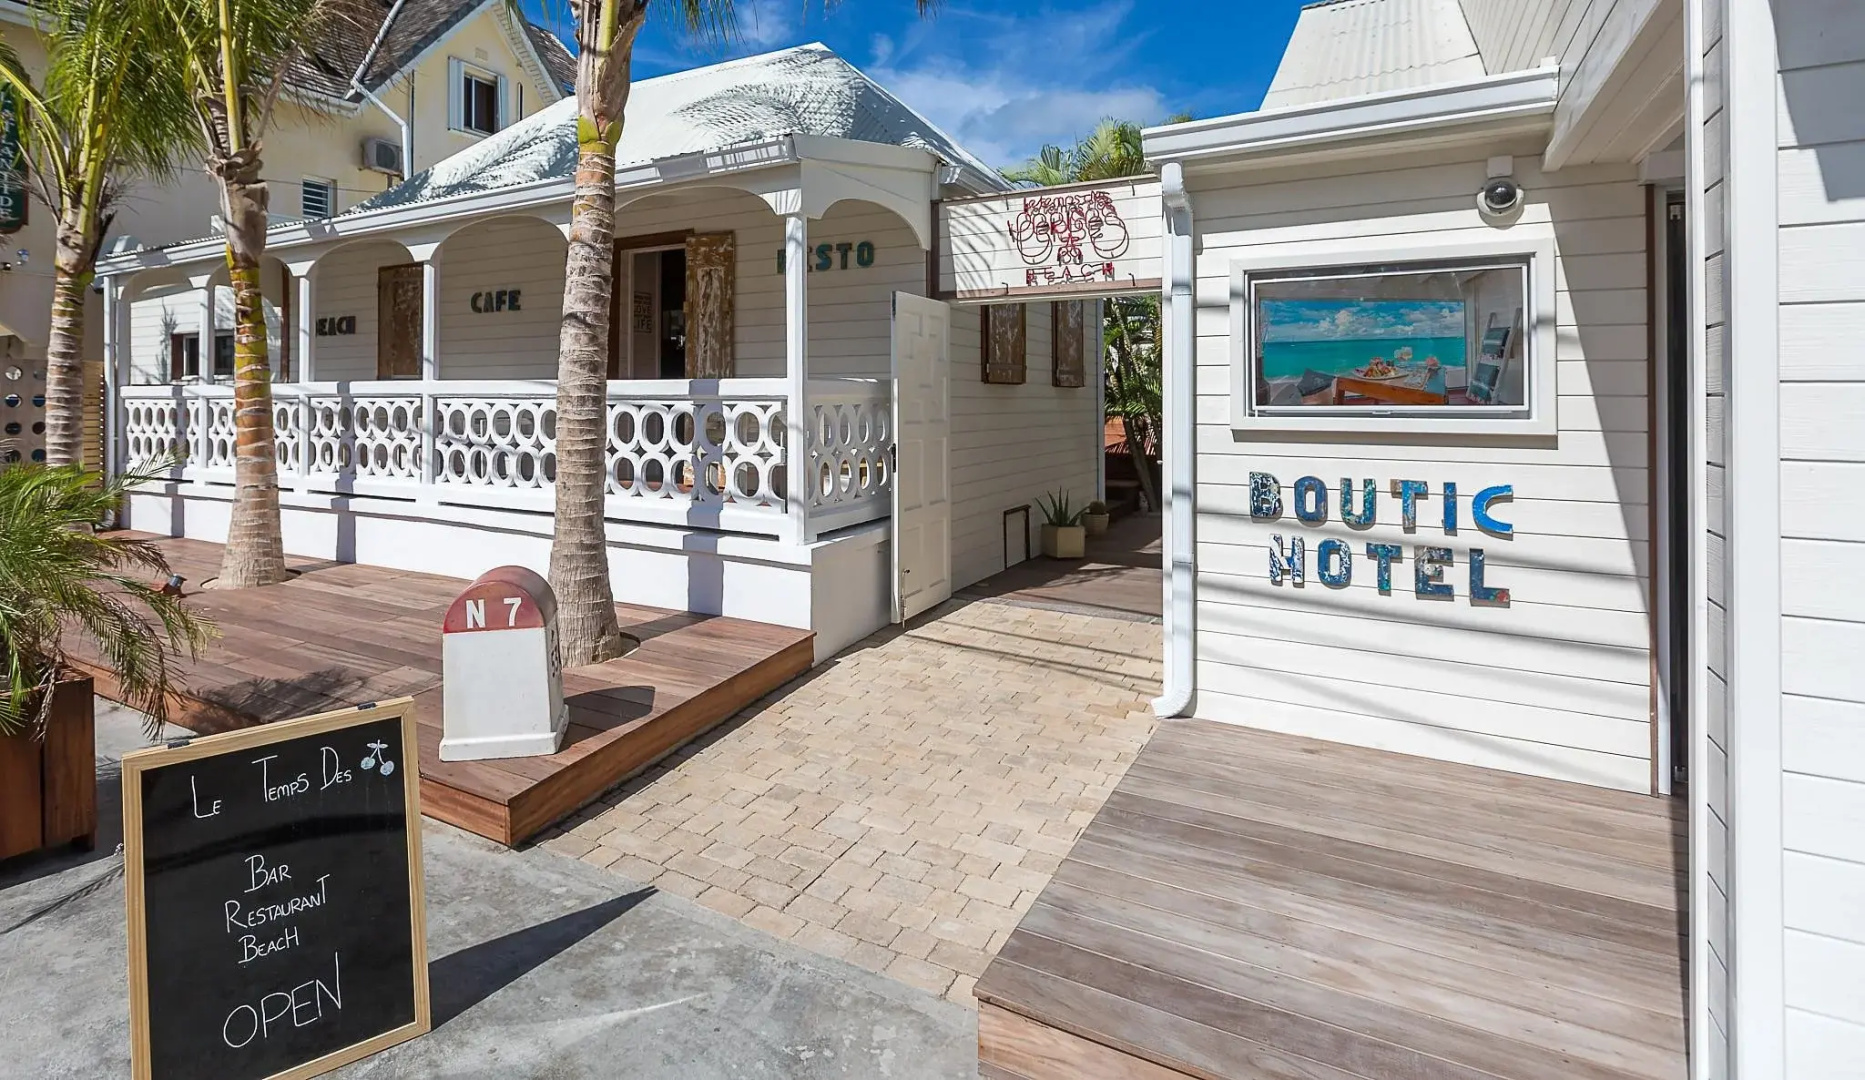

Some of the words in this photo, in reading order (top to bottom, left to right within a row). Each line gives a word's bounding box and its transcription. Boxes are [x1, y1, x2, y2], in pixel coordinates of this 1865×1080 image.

[470, 289, 522, 314] CAFE
[316, 316, 357, 337] EACH
[1249, 471, 1514, 540] BOUTIC
[1268, 533, 1511, 608] HOTEL
[465, 598, 486, 630] N
[503, 597, 522, 627] 7
[244, 854, 292, 893] BAR
[224, 873, 330, 934] RESTAURANT
[238, 926, 300, 964] BEACH
[223, 951, 342, 1048] OPEN
